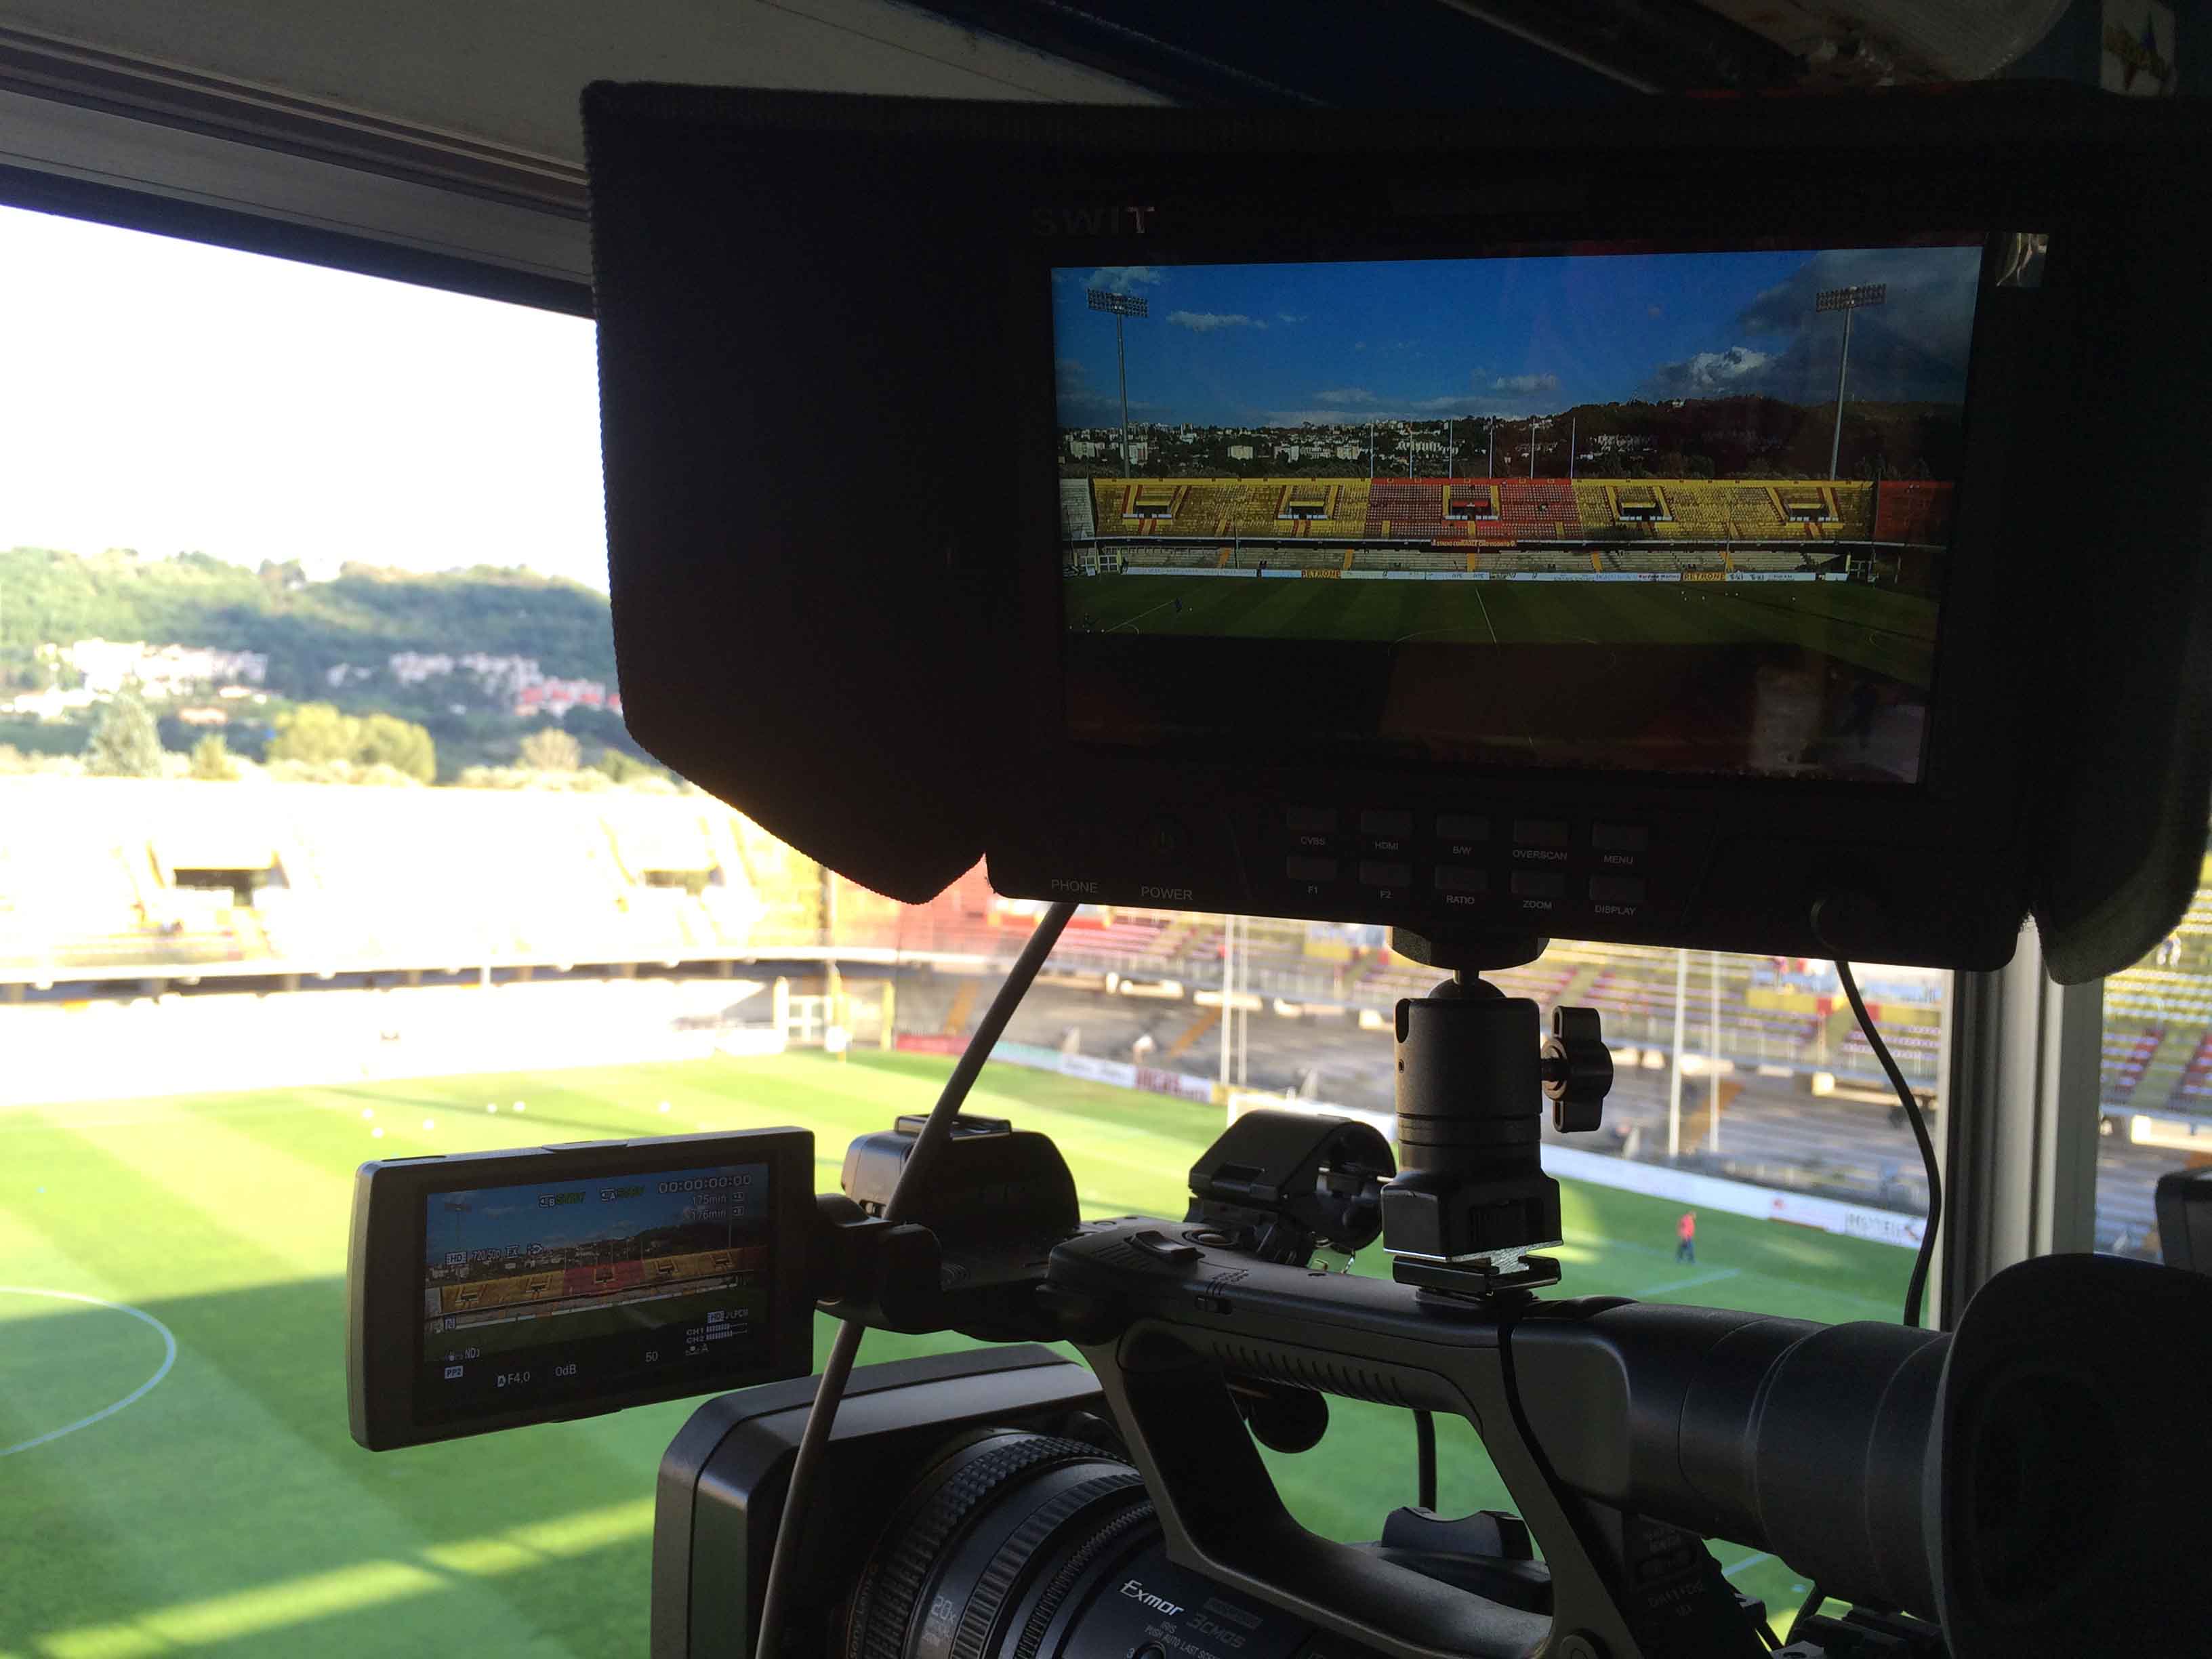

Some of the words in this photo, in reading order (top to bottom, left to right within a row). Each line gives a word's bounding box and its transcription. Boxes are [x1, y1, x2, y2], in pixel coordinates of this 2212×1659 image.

[1031, 205, 1156, 237] SWIT
[1300, 836, 1326, 846] CVBS
[1374, 840, 1399, 851] HDMI
[1452, 846, 1472, 856] B/W
[1512, 849, 1568, 861] OVERSCAN
[1603, 855, 1634, 865] MENU
[1051, 878, 1099, 895] PHONE
[1307, 885, 1318, 895] F1
[1140, 885, 1193, 901] POWER
[1379, 889, 1393, 899] F2
[1446, 894, 1475, 906] RATIO
[1523, 899, 1553, 910] ZOOM
[1594, 905, 1637, 916] DISPLAY
[657, 1174, 752, 1193] 00:00:00:00
[644, 1351, 658, 1363] 50
[555, 1364, 577, 1377] 0dB
[508, 1372, 531, 1384] F4.0
[1118, 1578, 1186, 1616] Exmor
[931, 1594, 957, 1625] 20x
